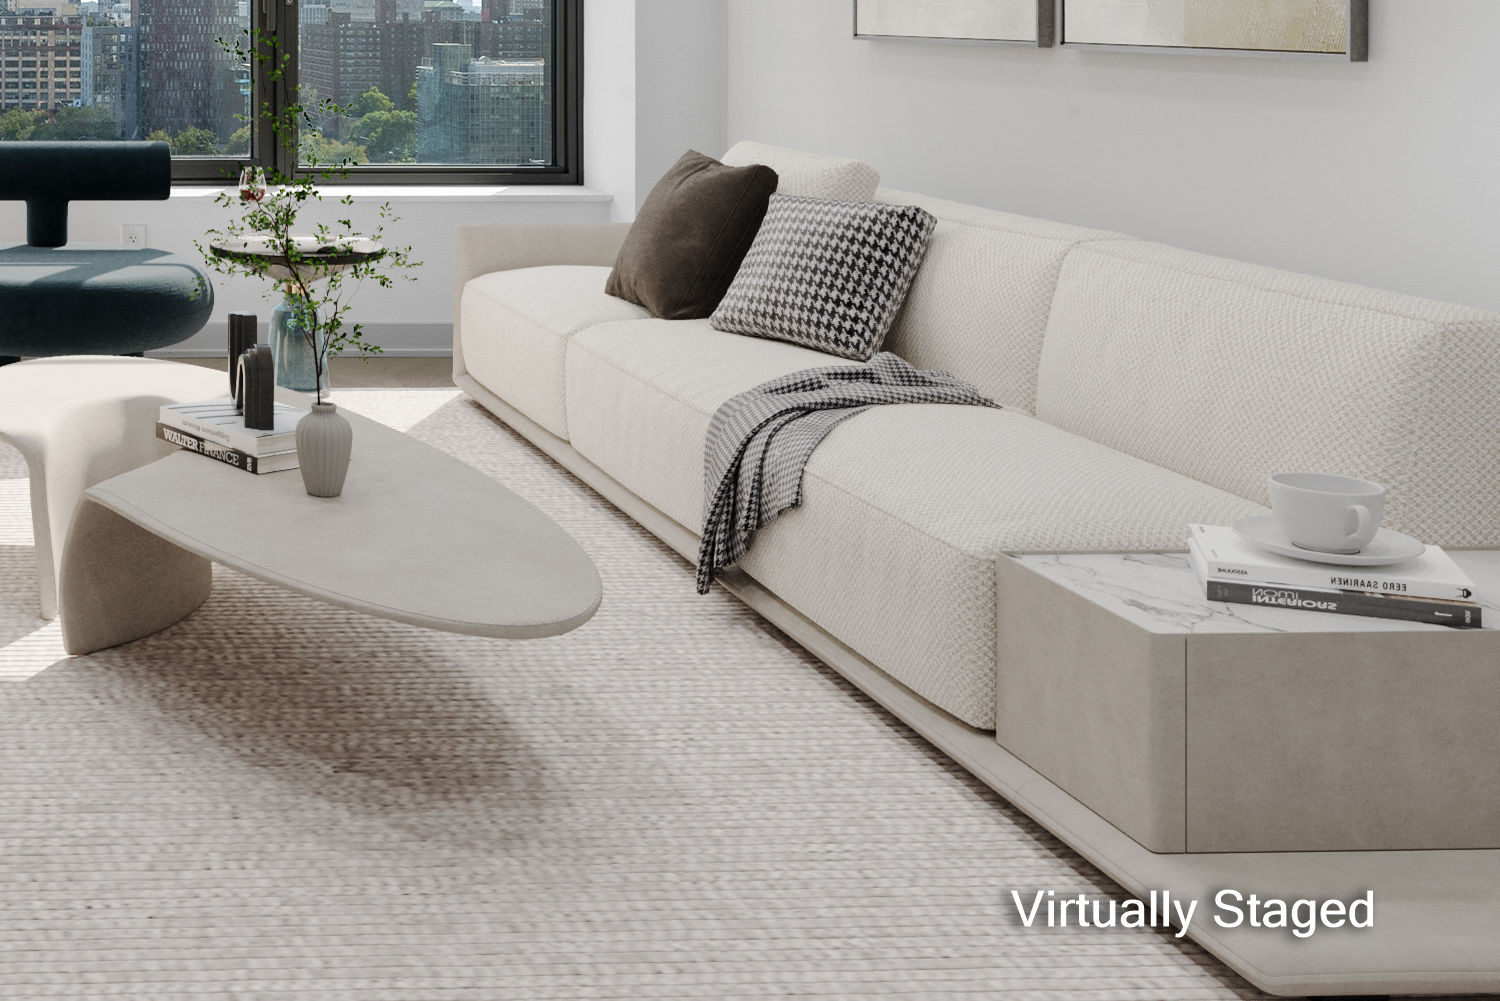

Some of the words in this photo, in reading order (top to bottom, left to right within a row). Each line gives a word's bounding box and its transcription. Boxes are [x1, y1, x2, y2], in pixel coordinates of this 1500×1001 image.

[181, 419, 201, 432] Museum
[162, 427, 199, 452] WALTER
[199, 440, 240, 466] FINANCE
